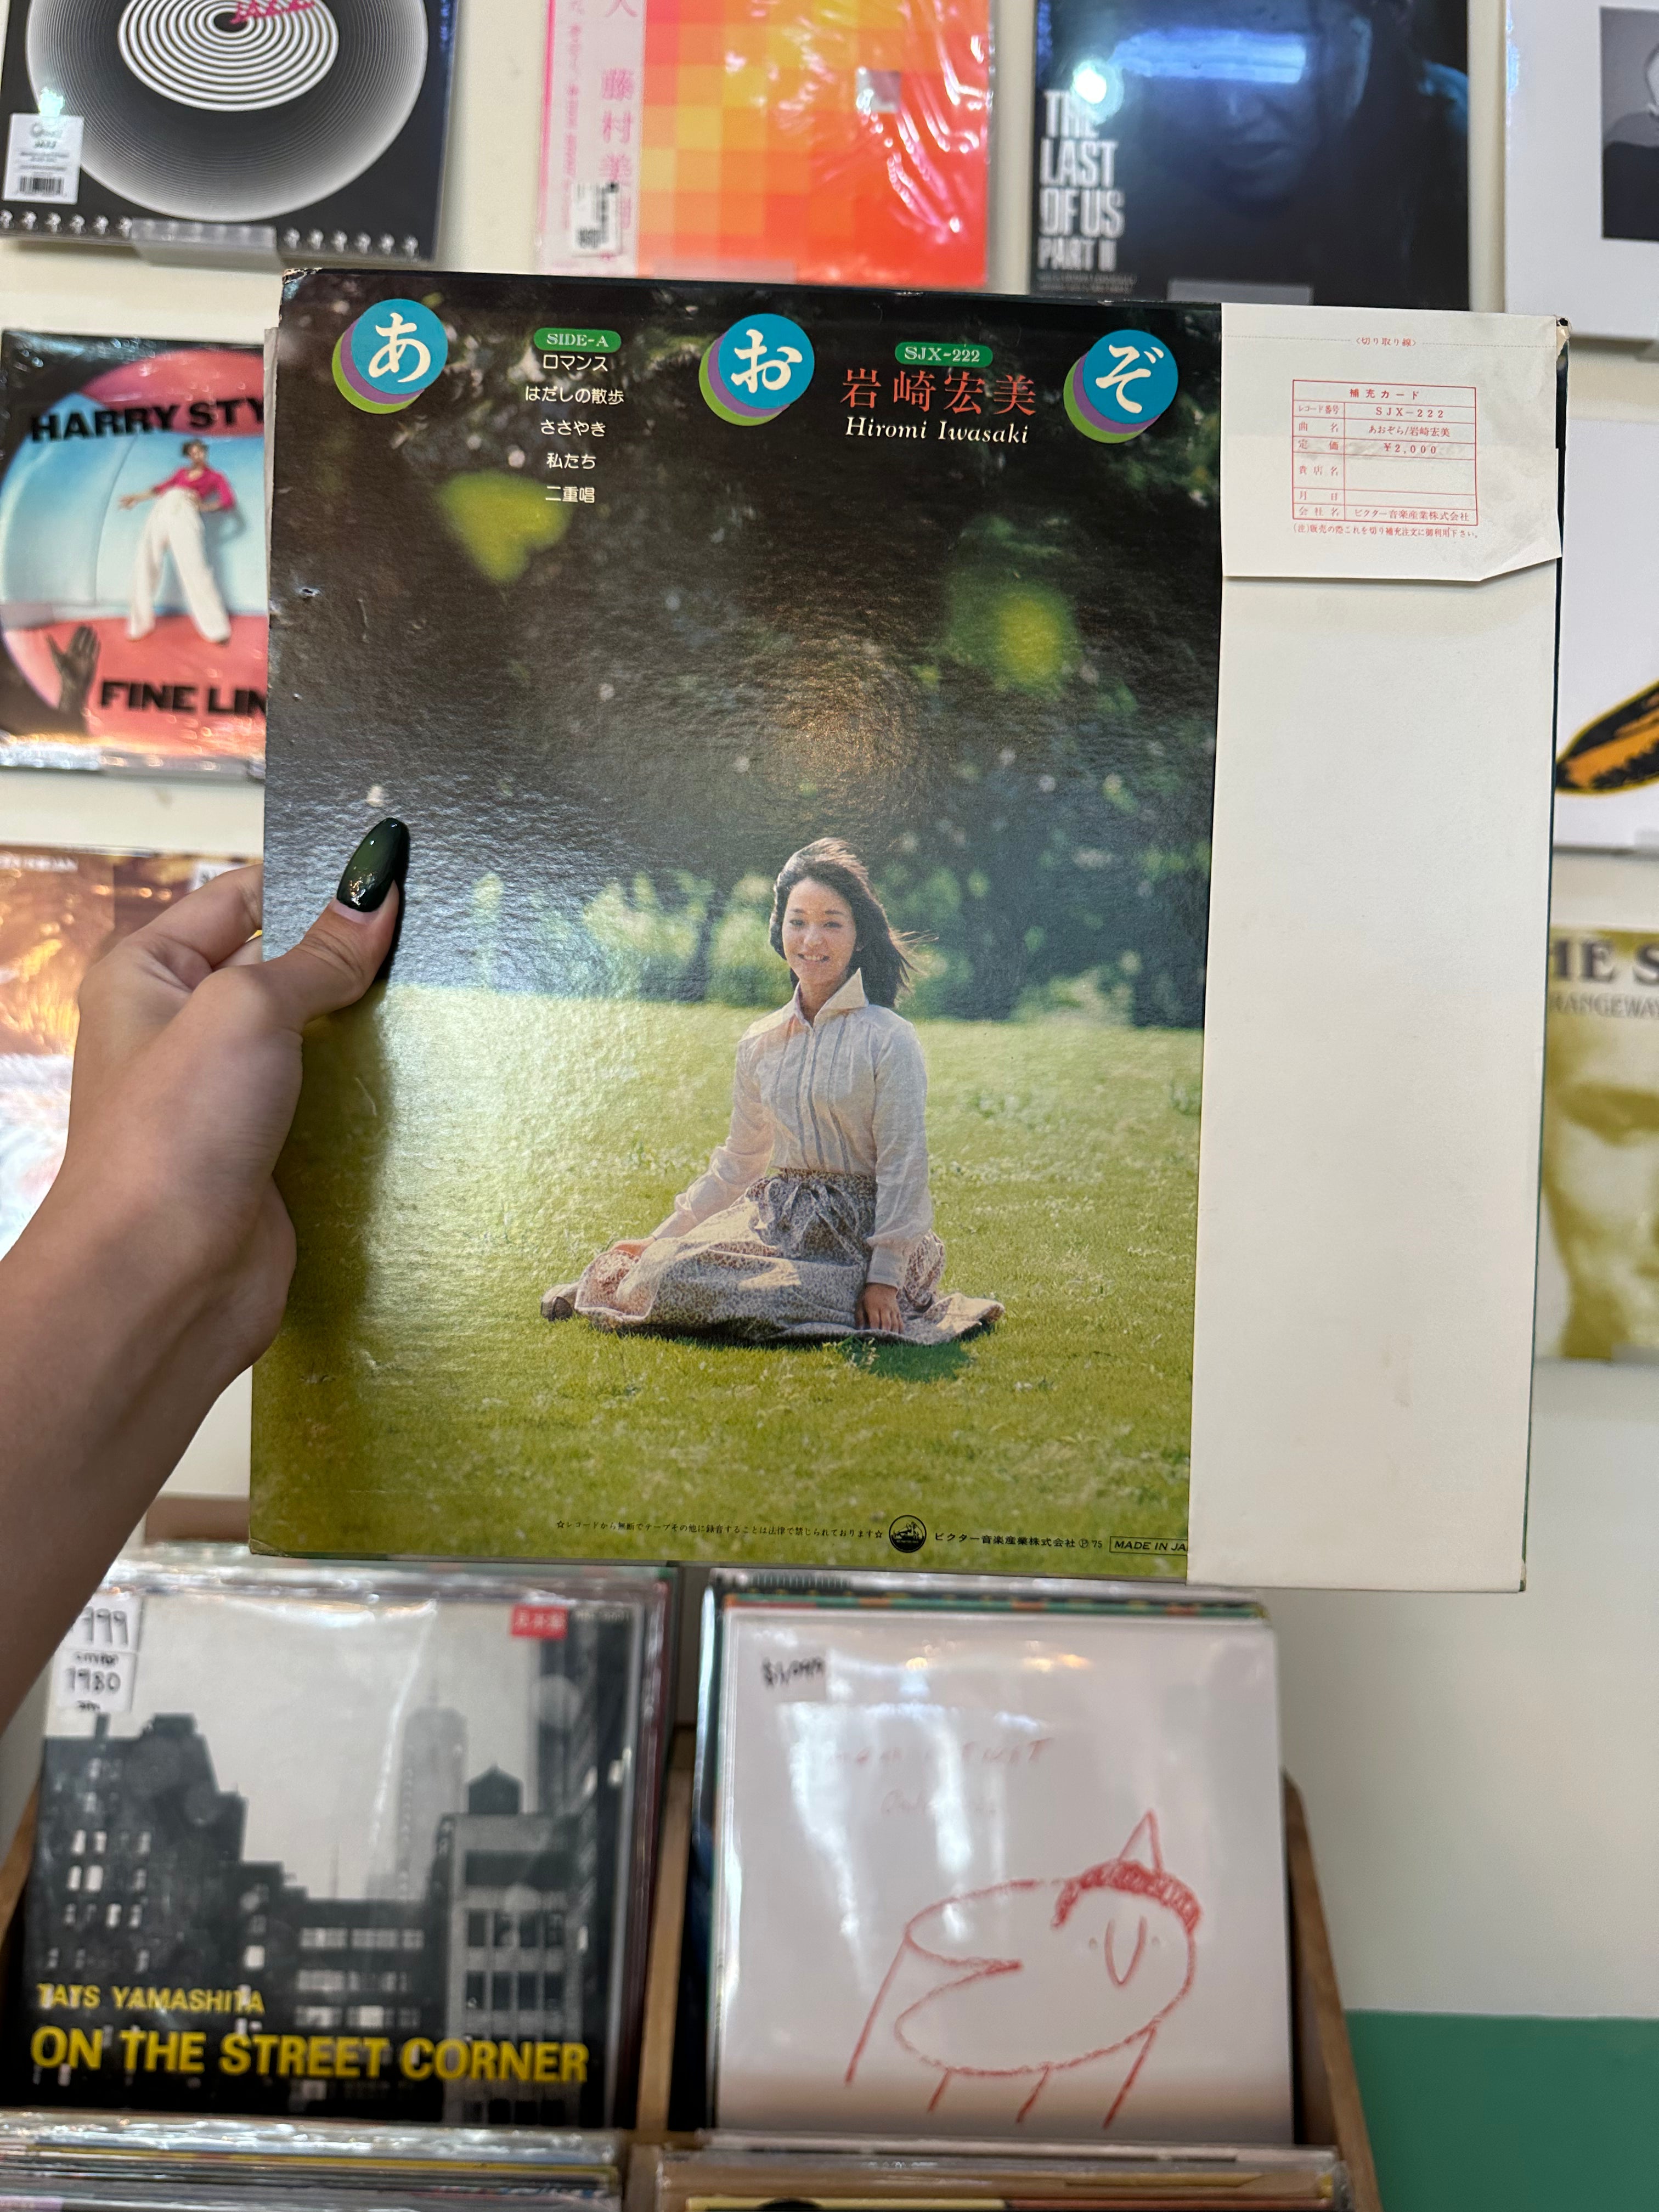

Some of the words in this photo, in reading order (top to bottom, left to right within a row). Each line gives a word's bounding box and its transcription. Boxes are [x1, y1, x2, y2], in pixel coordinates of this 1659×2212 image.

[1041, 139, 1119, 187] LAST
[1040, 189, 1079, 236] OF
[1081, 189, 1125, 238] US
[1037, 238, 1096, 271] PART
[368, 312, 431, 382] あ
[547, 334, 609, 347] SIDE-A
[543, 354, 608, 371] ロマンス
[731, 329, 803, 393] お
[905, 346, 980, 363] SJX-222
[840, 368, 1036, 416] 岩崎宏美
[1096, 345, 1164, 413] ぞ
[526, 386, 624, 405] はだしの散歩
[1299, 405, 1339, 414] レコード番号
[31, 404, 182, 443] HARRY
[540, 419, 606, 437] ささやき
[845, 416, 928, 439] Hiromi
[938, 420, 1029, 443] Iwasaki
[546, 452, 596, 469] 私たち
[545, 486, 595, 503] 二重唱
[1355, 509, 1469, 521] ビクター音楽産業株式会社
[101, 681, 197, 712] FINE
[935, 1532, 1075, 1548] ビクター音楽産業株式会社
[1114, 1541, 1151, 1550] MADE
[1154, 1542, 1168, 1550] IN
[1171, 1543, 1188, 1552] JA
[37, 1983, 101, 2010] TATS
[111, 1985, 266, 2015] YAMASHITA
[30, 2025, 103, 2069] ON
[120, 2030, 207, 2074] THE
[219, 2033, 391, 2079] STREET
[400, 2036, 590, 2083] CORNER
